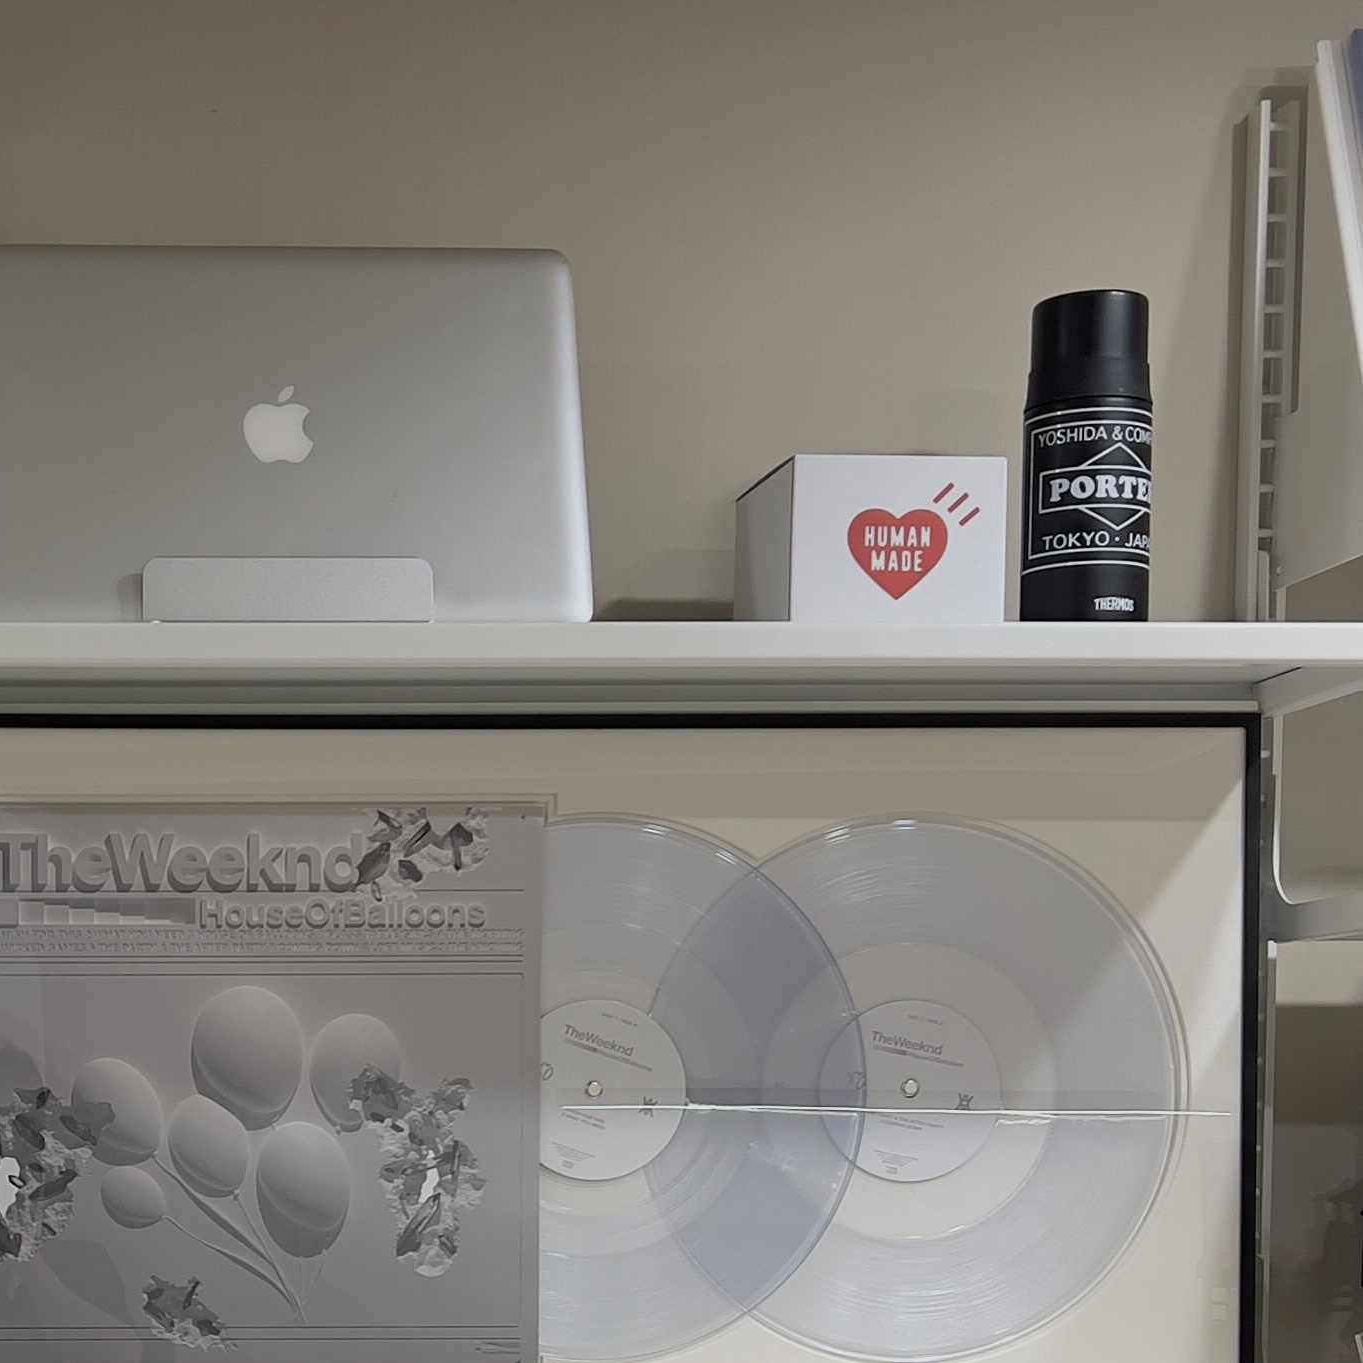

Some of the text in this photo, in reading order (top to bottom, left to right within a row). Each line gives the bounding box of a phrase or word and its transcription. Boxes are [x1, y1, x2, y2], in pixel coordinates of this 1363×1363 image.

[1038, 426, 1107, 447] YOSHIDA
[1112, 425, 1123, 441] &
[864, 525, 931, 547] HUMAN
[1042, 531, 1110, 550] TOKYO
[871, 550, 924, 572] MADE
[1093, 597, 1134, 612] THERMOS
[199, 898, 486, 929] HouseOfBalloons
[564, 1024, 634, 1057] TheWeeknd
[871, 1030, 944, 1055] TheWeeknd
